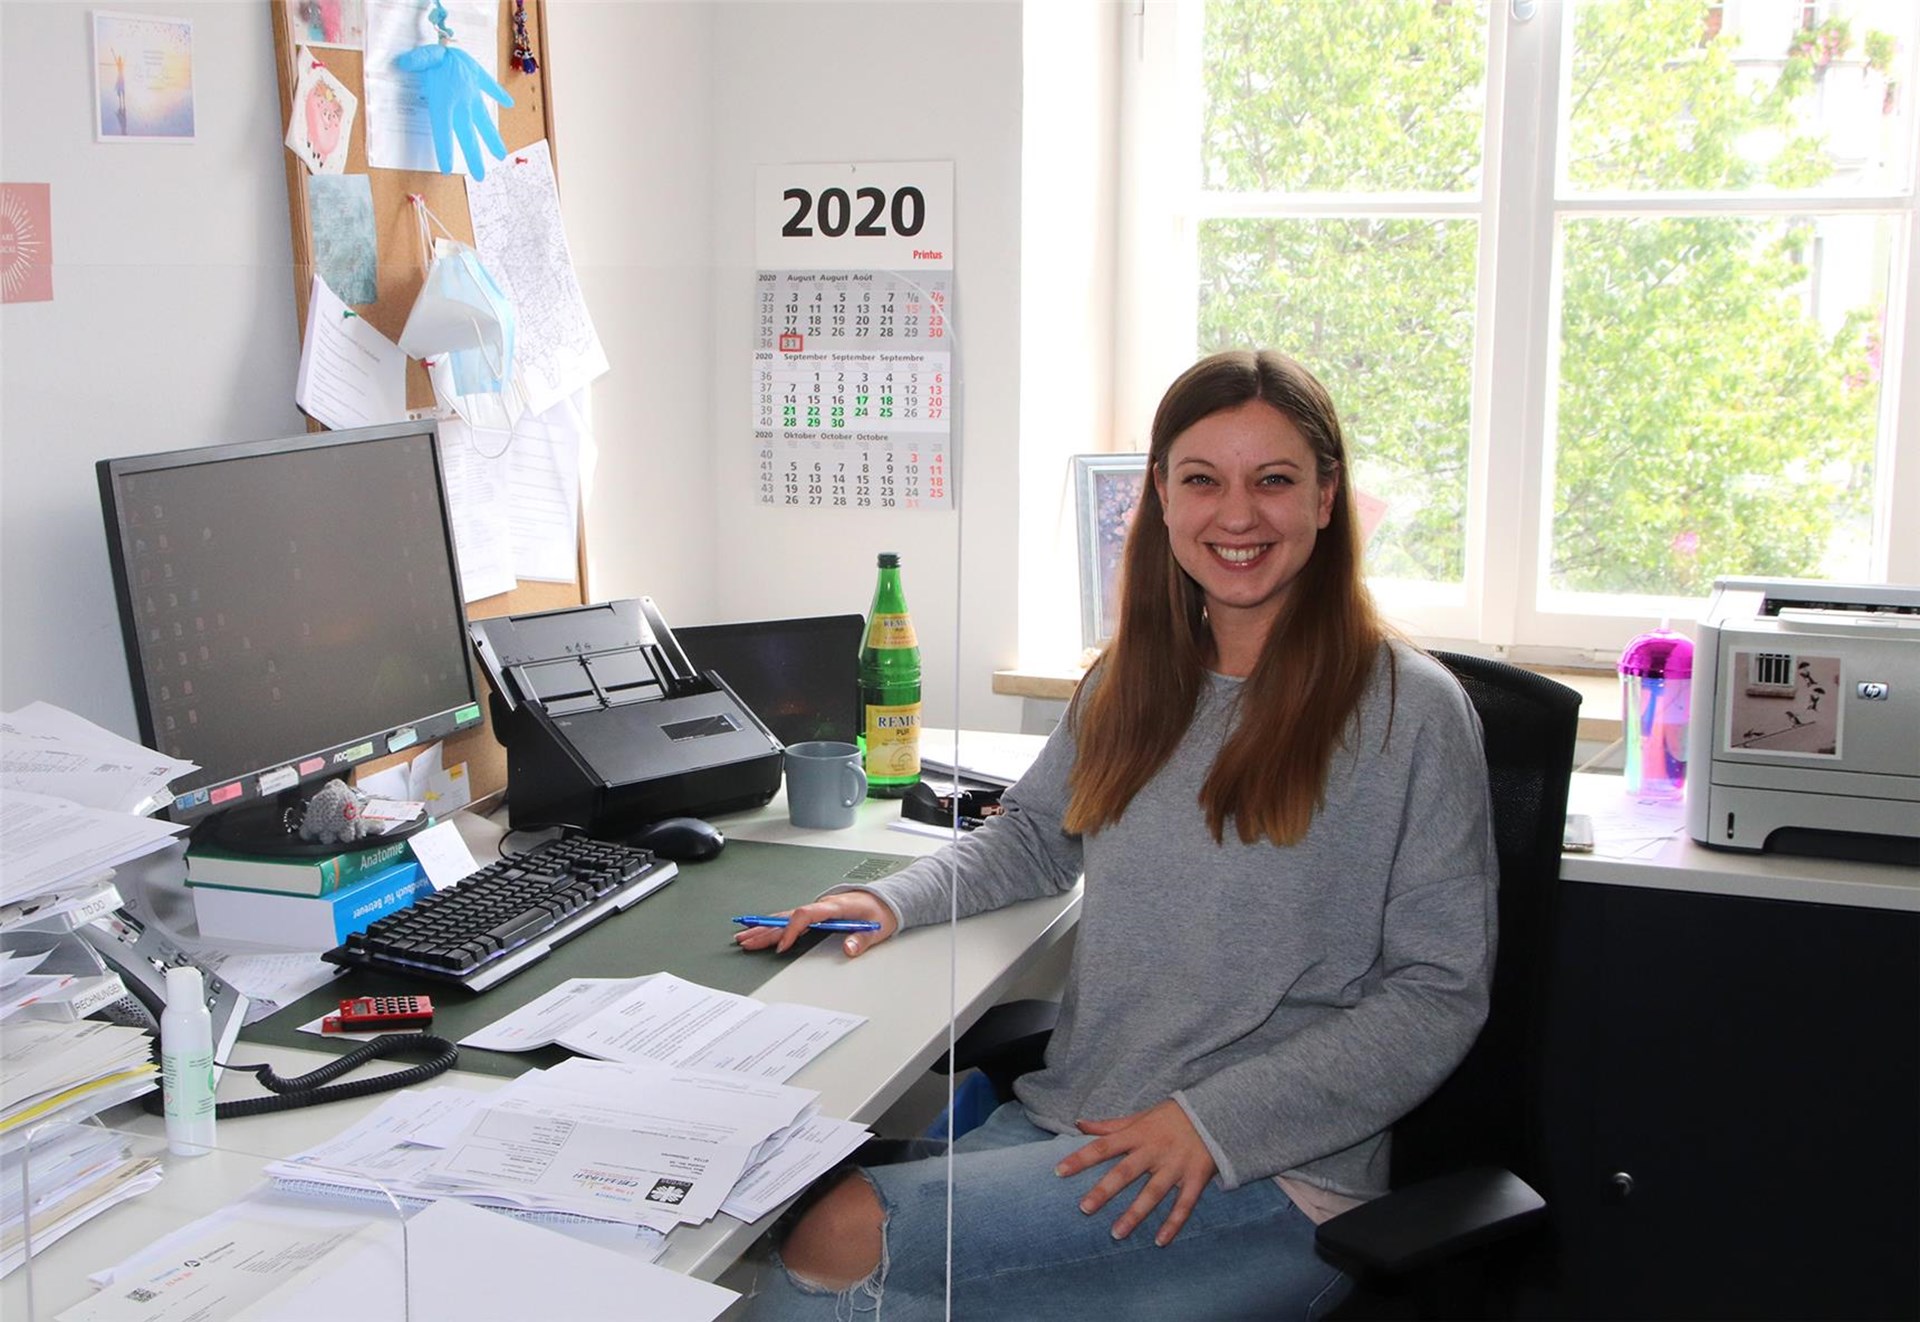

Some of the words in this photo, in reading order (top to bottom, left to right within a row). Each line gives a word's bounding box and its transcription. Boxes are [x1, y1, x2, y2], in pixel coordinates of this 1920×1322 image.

[782, 187, 925, 237] 2020
[913, 251, 943, 259] Printus
[787, 274, 815, 282] August
[820, 274, 848, 282] August
[762, 294, 774, 302] 32
[793, 293, 798, 301] 3
[815, 293, 822, 301] 4
[840, 293, 846, 301] 5
[863, 293, 870, 302] 6
[888, 293, 895, 301] 7
[762, 305, 773, 313] 33
[785, 305, 798, 313] 10
[810, 305, 821, 313] 11
[833, 305, 845, 313] 12
[857, 305, 869, 313] 13
[881, 305, 894, 313] 14
[761, 316, 773, 324] 34
[785, 316, 797, 324] 17
[809, 316, 821, 324] 18
[833, 316, 845, 324] 19
[856, 316, 869, 325] 20
[880, 316, 893, 325] 21
[904, 317, 918, 325] 22
[929, 317, 943, 325] 23
[761, 328, 773, 336] 35
[808, 328, 821, 336] 25
[832, 328, 844, 336] 26
[856, 328, 869, 337] 27
[880, 328, 893, 337] 28
[904, 328, 918, 337] 29
[929, 328, 943, 337] 30
[761, 339, 773, 347] 36
[784, 339, 796, 347] 31
[880, 354, 924, 362] Septembre
[760, 372, 772, 381] 36
[838, 373, 844, 381] 2
[862, 373, 868, 381] 3
[886, 374, 892, 382] 4
[911, 374, 917, 382] 5
[936, 375, 942, 383] 6
[760, 384, 772, 392] 37
[814, 385, 820, 393] 8
[838, 385, 844, 393] 9
[856, 385, 868, 393] 10
[880, 385, 892, 393] 11
[905, 386, 917, 394] 12
[930, 386, 942, 394] 13
[760, 395, 772, 403] 38
[784, 396, 796, 404] 14
[808, 396, 820, 404] 15
[832, 396, 844, 404] 16
[856, 396, 868, 405] 17
[881, 396, 893, 405] 18
[905, 397, 918, 406] 19
[929, 397, 942, 406] 20
[760, 407, 772, 415] 39
[784, 407, 796, 415] 21
[808, 407, 820, 416] 22
[831, 407, 844, 416] 23
[855, 408, 868, 416] 24
[880, 408, 893, 417] 25
[904, 409, 918, 418] 26
[929, 409, 942, 418] 27
[760, 418, 772, 426] 40
[784, 418, 796, 426] 28
[808, 418, 820, 427] 29
[832, 419, 844, 428] 30
[760, 450, 773, 459] 40
[887, 453, 893, 462] 2
[911, 454, 918, 462] 3
[936, 454, 942, 462] 4
[760, 462, 773, 470] 41
[791, 463, 797, 471] 5
[814, 463, 821, 471] 6
[863, 464, 869, 473] 8
[887, 465, 893, 473] 9
[905, 465, 918, 474] 10
[930, 466, 942, 474] 11
[761, 473, 773, 481] 42
[785, 474, 797, 482] 12
[809, 474, 821, 483] 13
[833, 475, 845, 483] 14
[857, 475, 869, 484] 15
[881, 476, 893, 485] 16
[905, 477, 918, 485] 17
[930, 477, 943, 486] 18
[761, 485, 773, 493] 43
[785, 485, 798, 493] 19
[809, 485, 822, 494] 20
[833, 486, 845, 494] 21
[856, 487, 869, 495] 22
[881, 487, 894, 496] 23
[905, 488, 919, 496] 24
[930, 488, 944, 497] 25
[785, 496, 798, 504] 26
[809, 496, 822, 505] 27
[833, 497, 846, 505] 28
[857, 498, 870, 506] 29
[882, 498, 895, 507] 30
[360, 842, 404, 871] Anatomie
[384, 893, 395, 905] für
[82, 905, 94, 915] TO
[95, 900, 105, 911] DO
[353, 898, 383, 919] Betreuer
[74, 982, 120, 1010] RECHNUNGE
